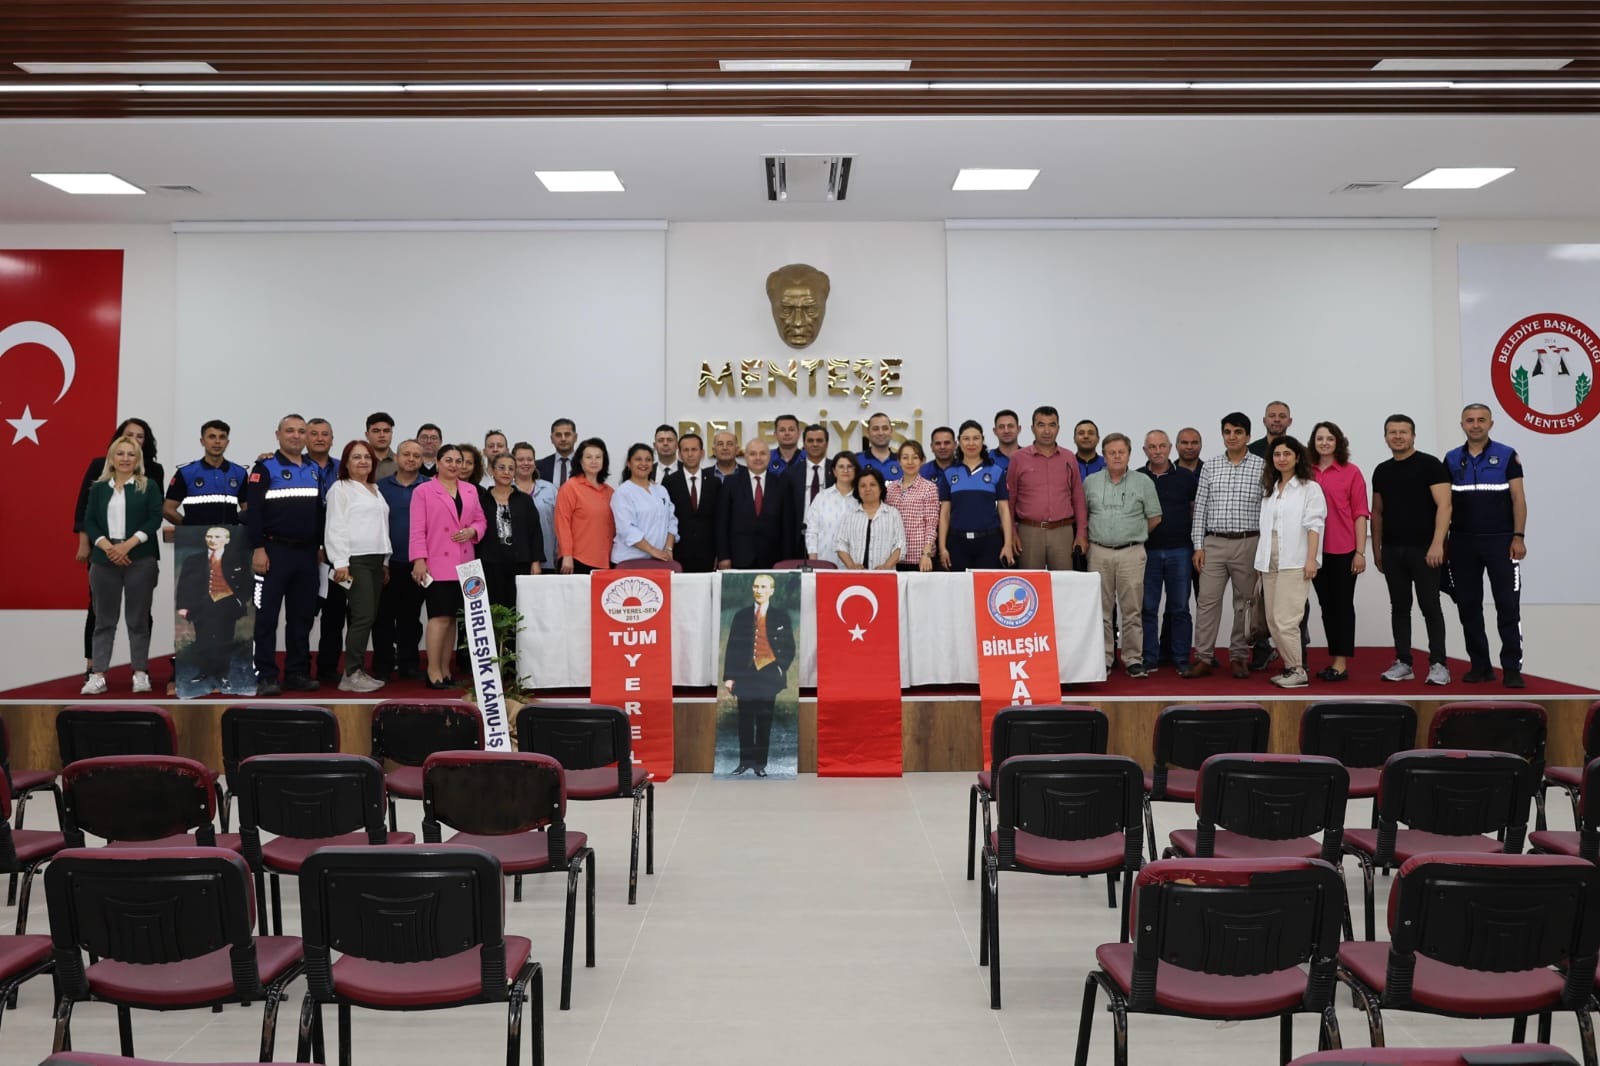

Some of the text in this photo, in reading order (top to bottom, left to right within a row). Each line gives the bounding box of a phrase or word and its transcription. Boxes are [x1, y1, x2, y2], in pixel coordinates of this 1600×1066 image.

[1498, 320, 1542, 364] BELEDİYE
[697, 358, 903, 408] MENTEŞE
[1523, 412, 1584, 429] MENTEŞE
[622, 607, 657, 615] YEREL-SEN
[608, 627, 657, 646] TÜM
[982, 632, 1050, 657] BİRLEŞİK
[481, 679, 504, 748] KAMU-İŞ
